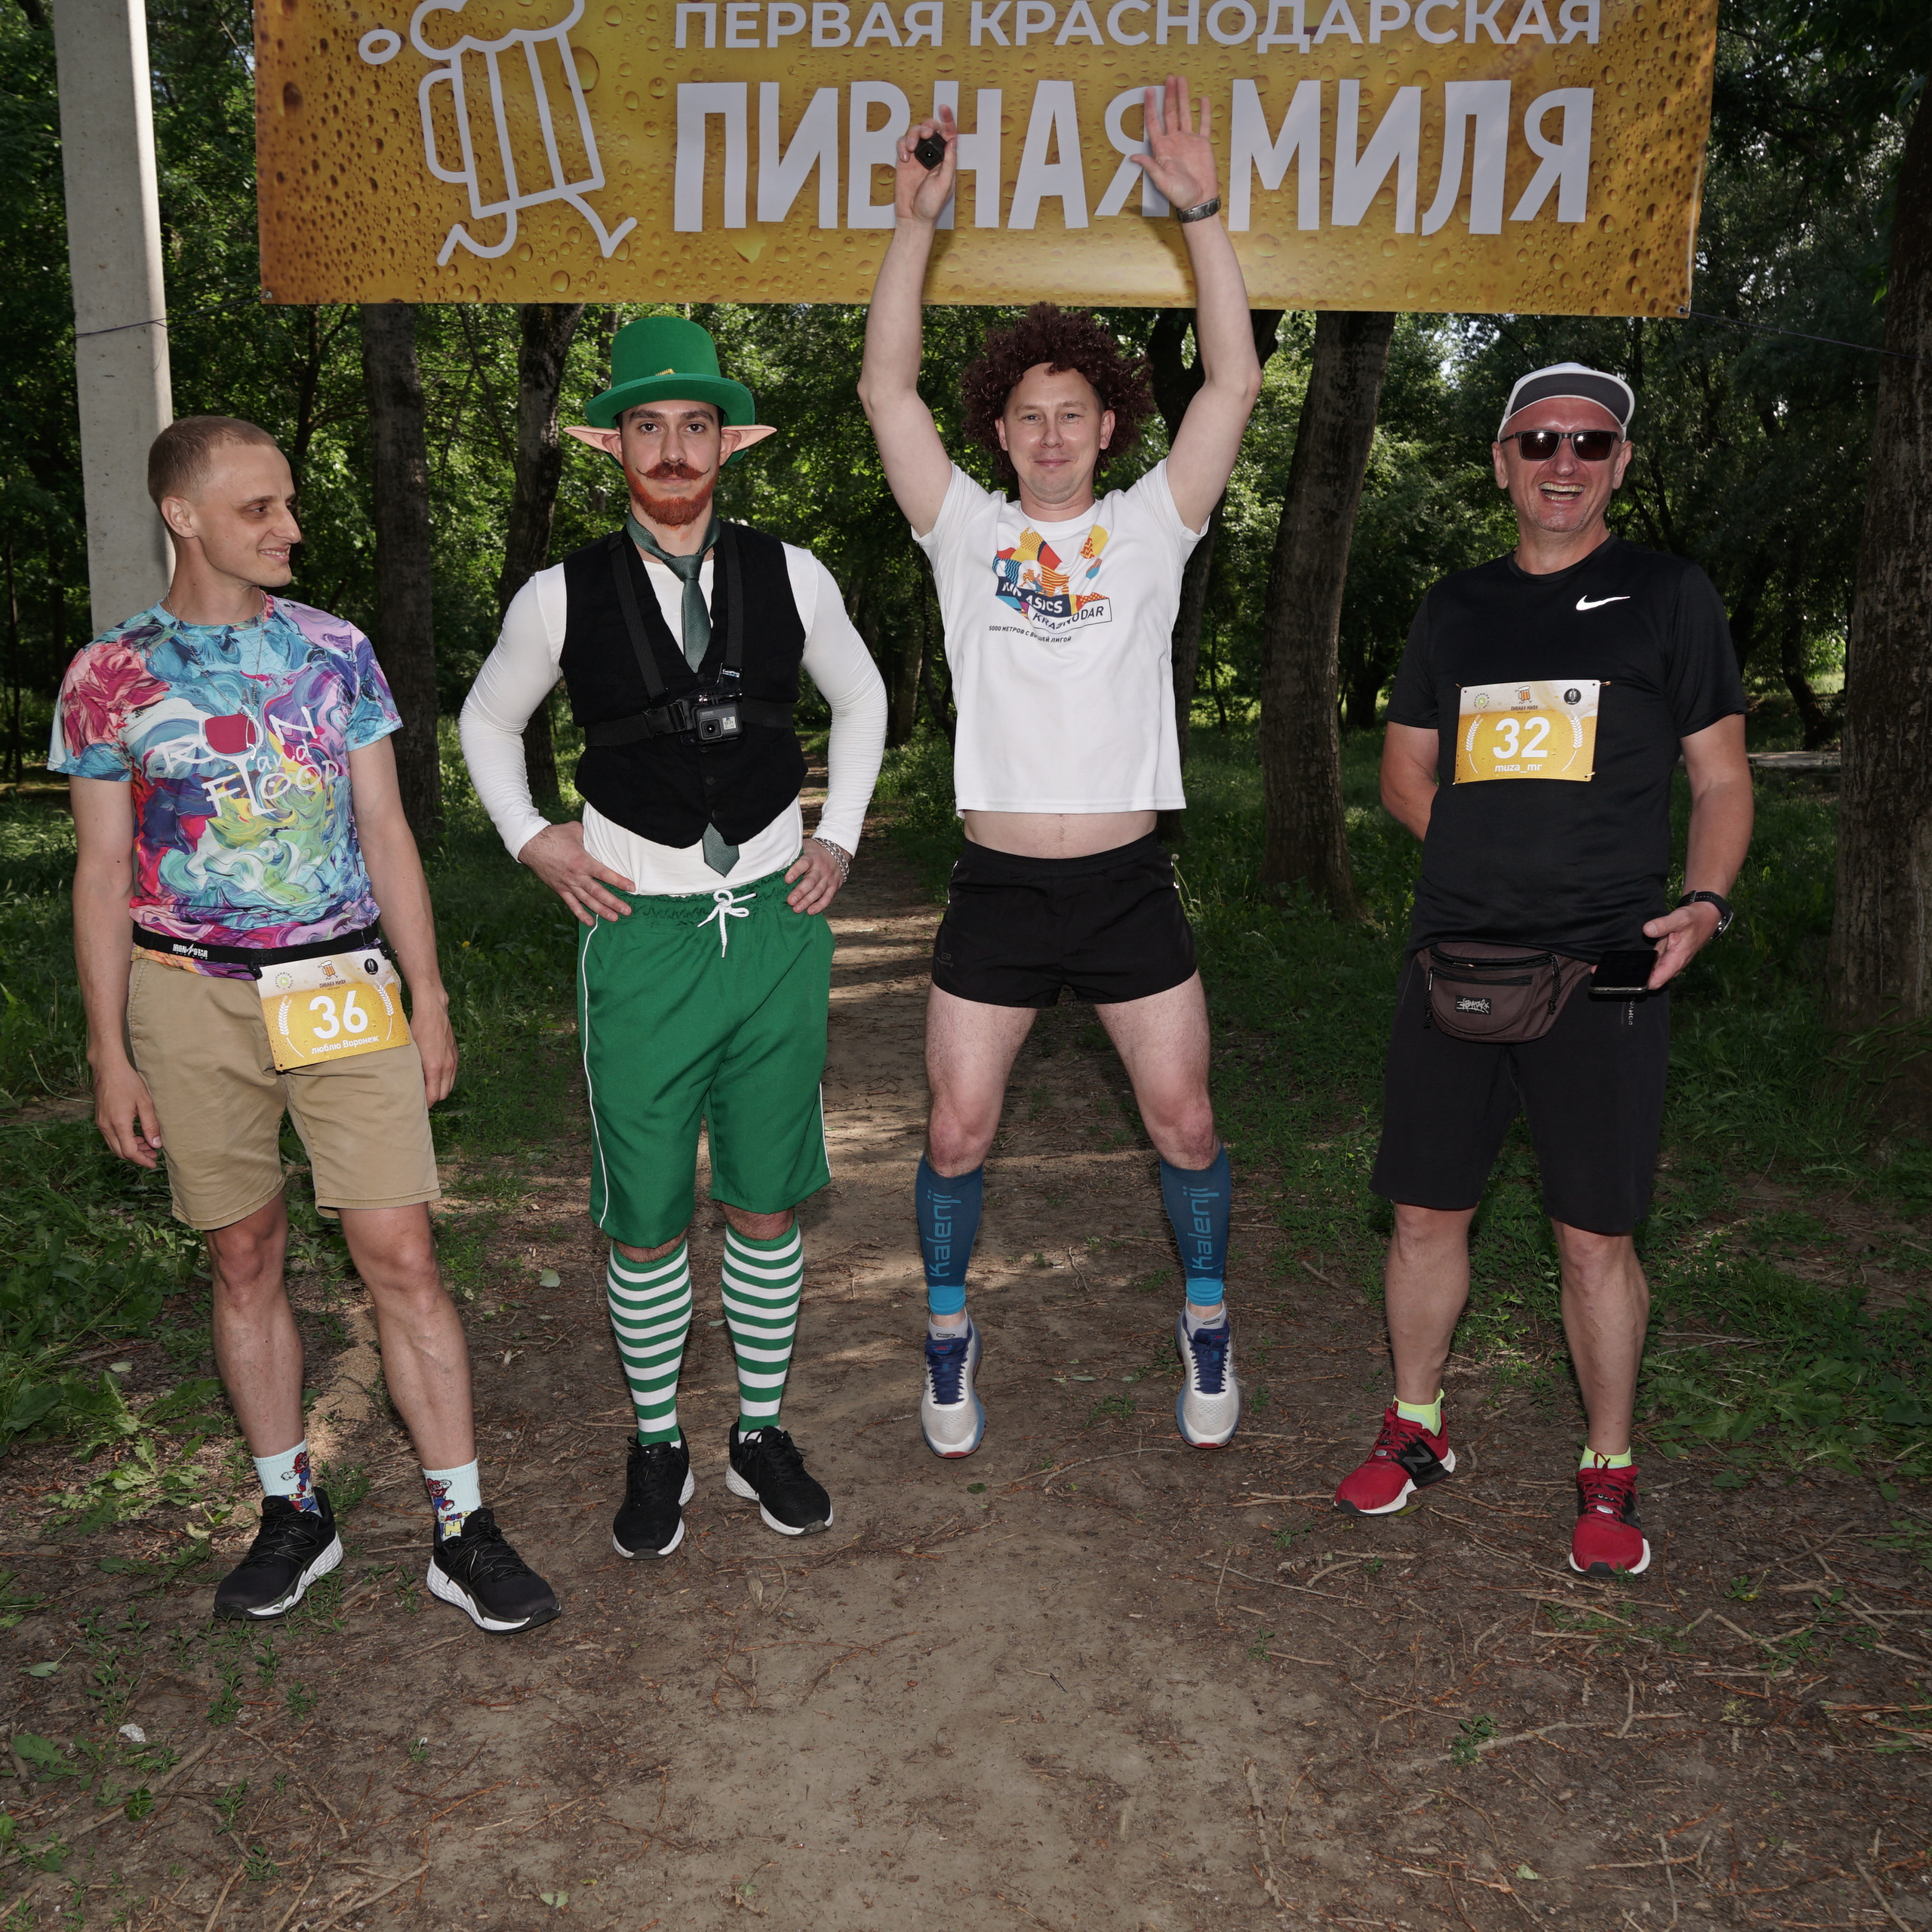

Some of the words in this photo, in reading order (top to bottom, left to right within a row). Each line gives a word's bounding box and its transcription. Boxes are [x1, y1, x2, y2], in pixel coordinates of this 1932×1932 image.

[675, 2, 943, 48] ПЕРВАЯ
[971, 0, 1601, 54] КРАСНОДАРСКАЯ
[673, 80, 1171, 232] ПИВНАЯ
[1227, 79, 1595, 236] МИЛЯ
[1026, 595, 1063, 614] ASICS
[1002, 626, 1025, 635] МЕТРОВ
[257, 739, 312, 773] and
[1493, 716, 1550, 759] 32
[1494, 763, 1543, 773] muza_mr
[309, 990, 368, 1040] 36
[311, 1041, 341, 1054] люблю
[343, 1035, 380, 1049] Воронеж
[926, 1189, 961, 1277] kalenji
[1183, 1186, 1219, 1270] kalenji
